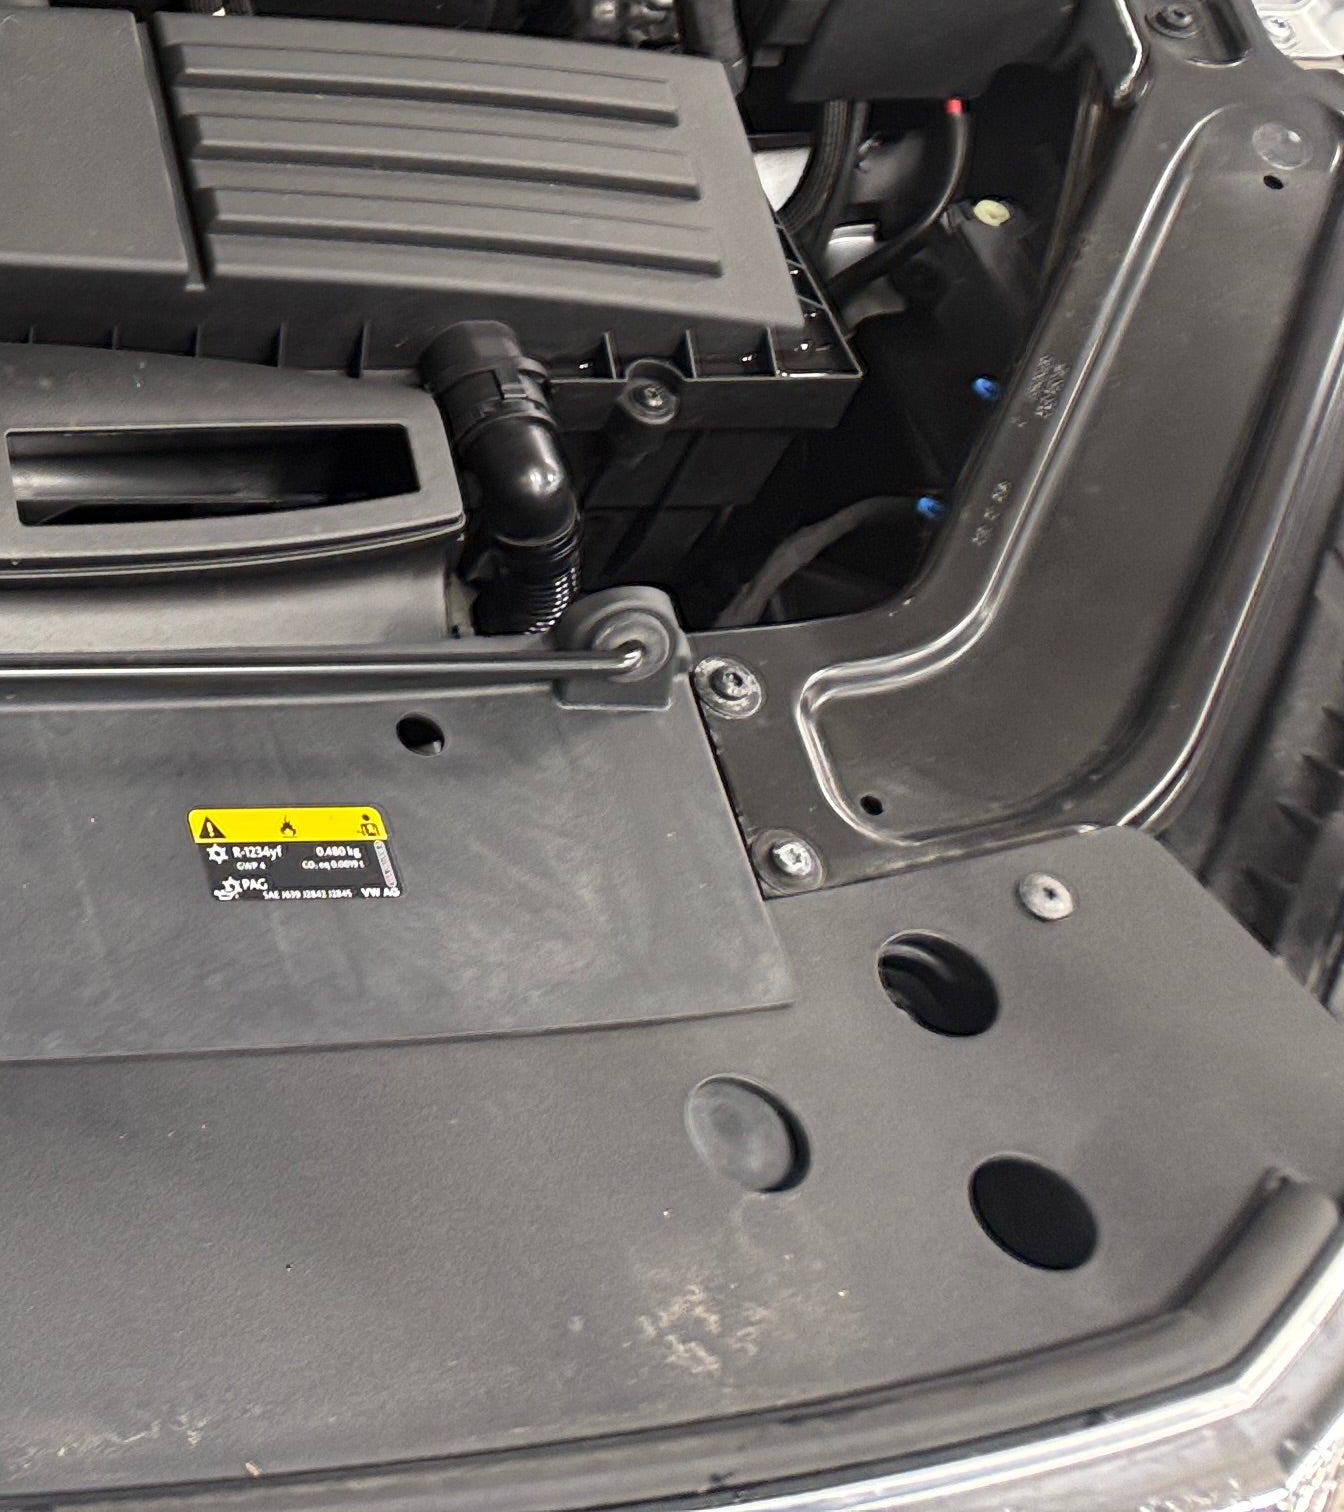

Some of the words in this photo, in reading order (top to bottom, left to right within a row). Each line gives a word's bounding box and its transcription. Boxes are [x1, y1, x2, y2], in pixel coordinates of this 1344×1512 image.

[232, 846, 284, 861] R-1234yf
[346, 846, 362, 860] kg
[241, 878, 269, 890] PAG
[262, 890, 280, 900] SAE
[361, 887, 381, 898] VW
[383, 887, 401, 897] AG
